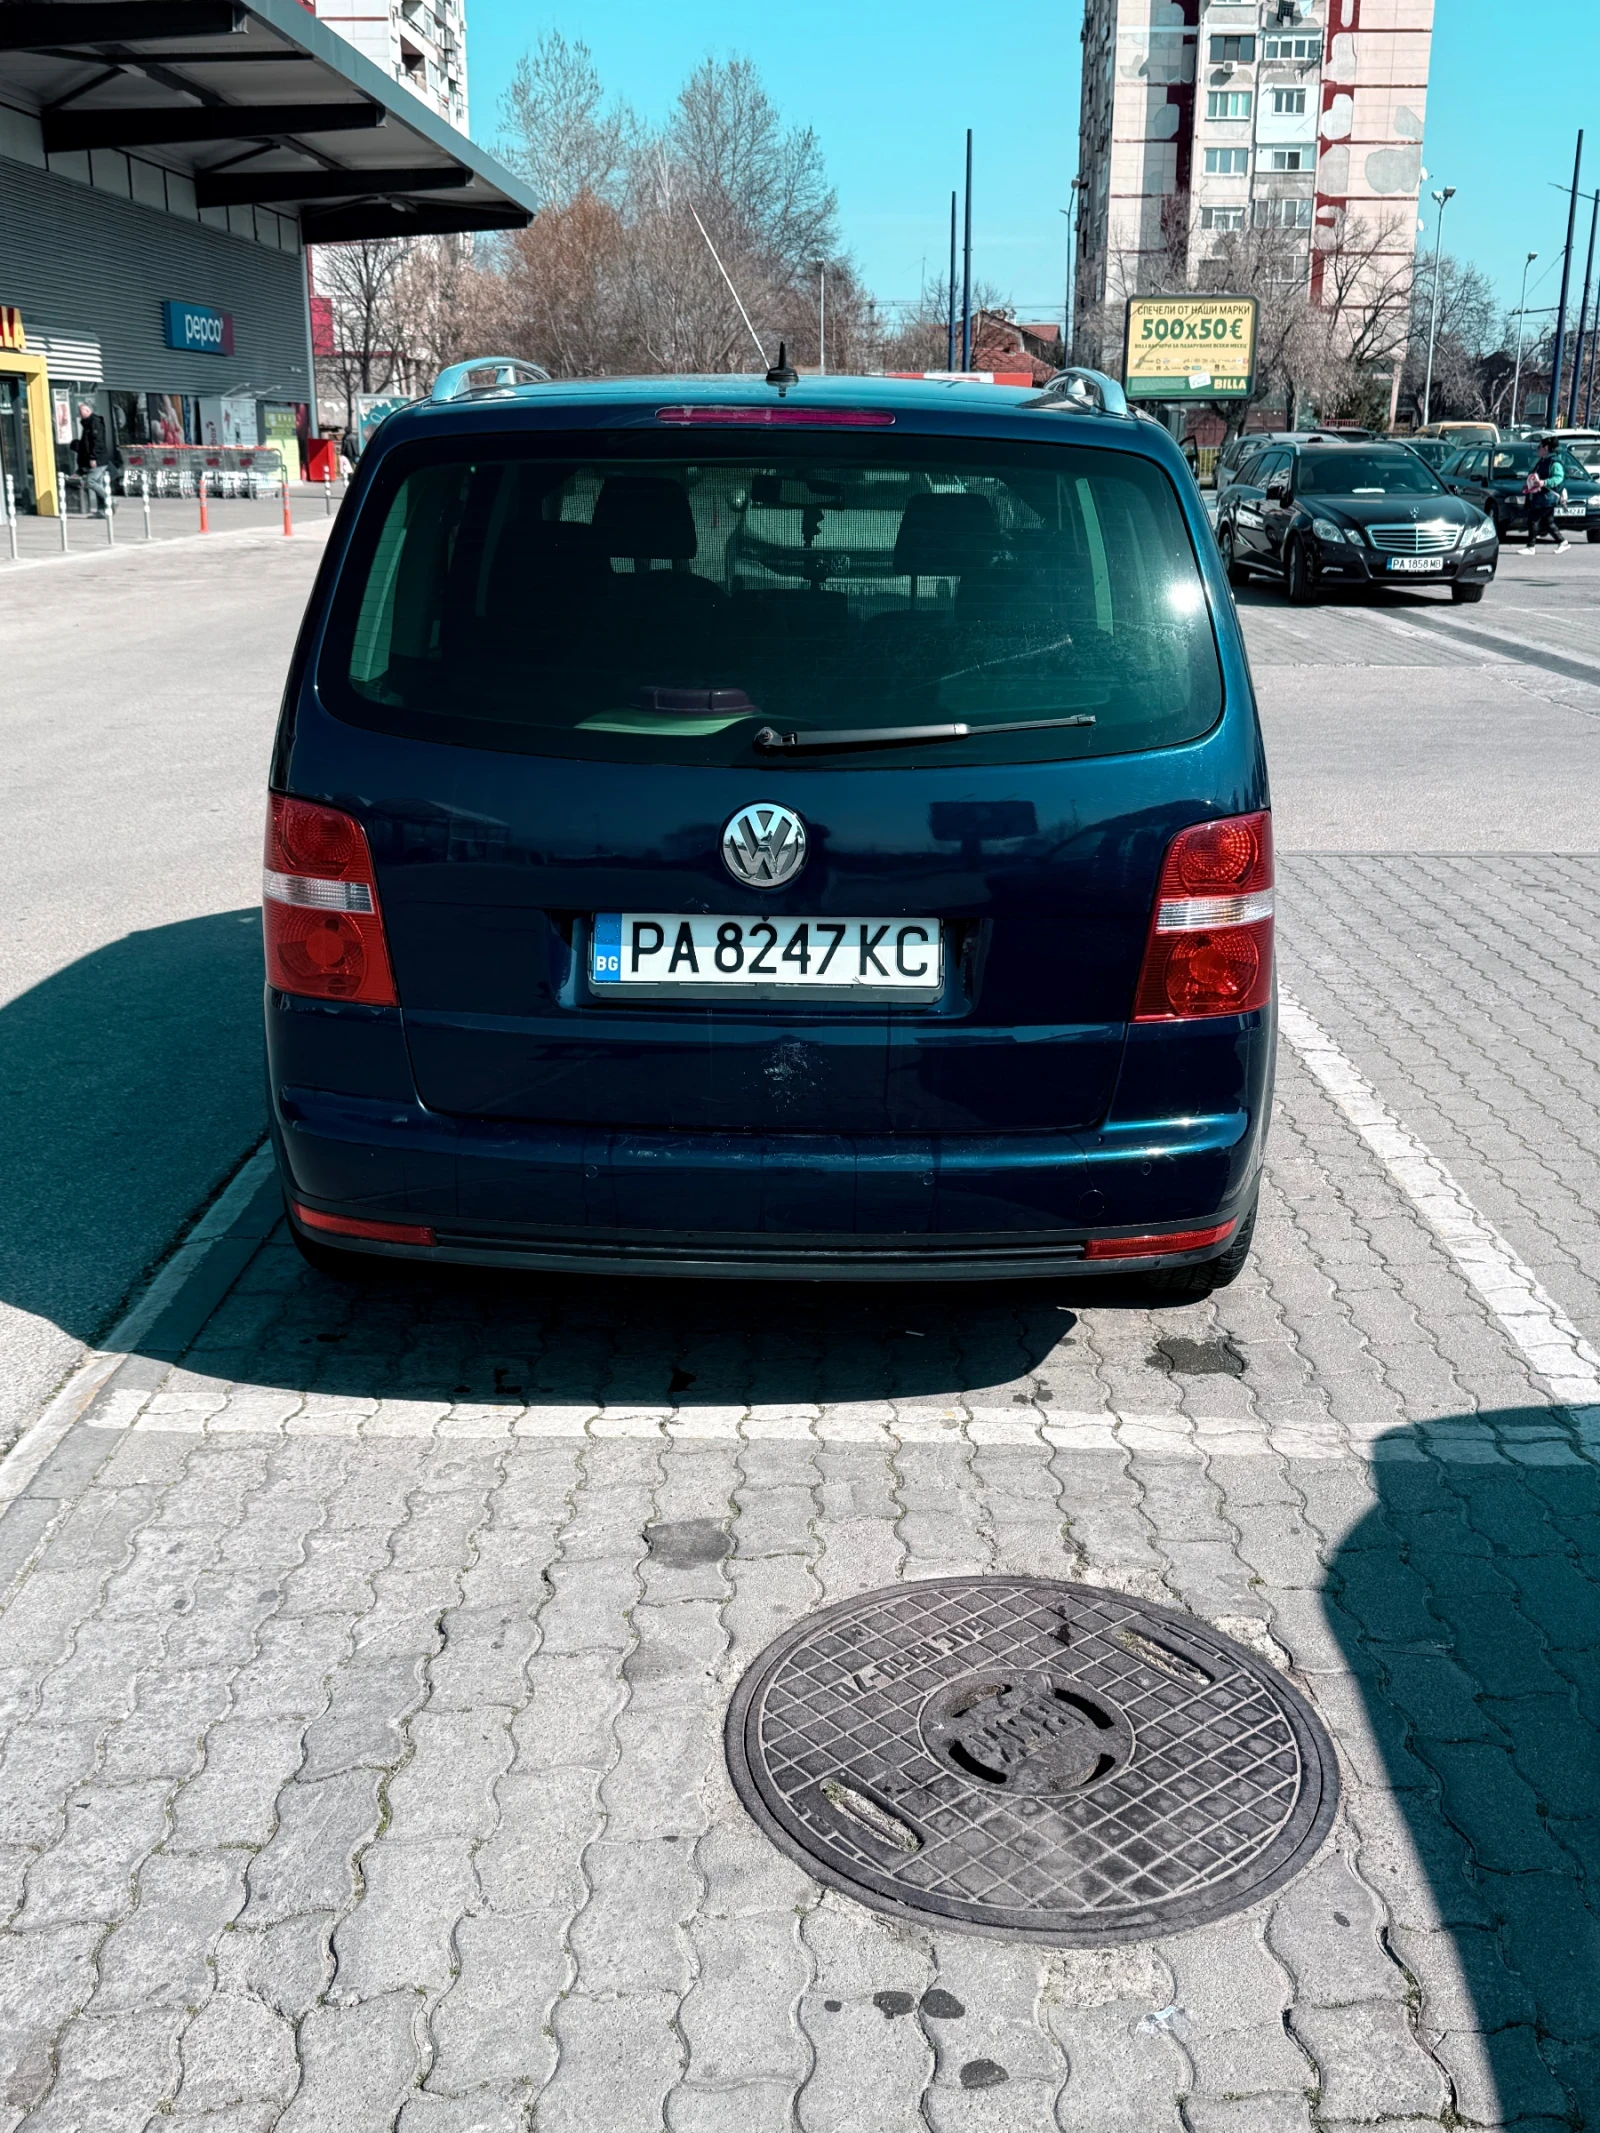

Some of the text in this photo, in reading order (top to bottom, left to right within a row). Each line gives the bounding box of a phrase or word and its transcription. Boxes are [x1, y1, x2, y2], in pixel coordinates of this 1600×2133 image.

[1137, 305, 1250, 316] СПЕЧЕЛИ ОТ НАШИ МАРКИ
[185, 314, 222, 347] pepco
[1214, 378, 1247, 390] BILLA
[714, 922, 847, 976] 8247
[596, 955, 619, 972] BG
